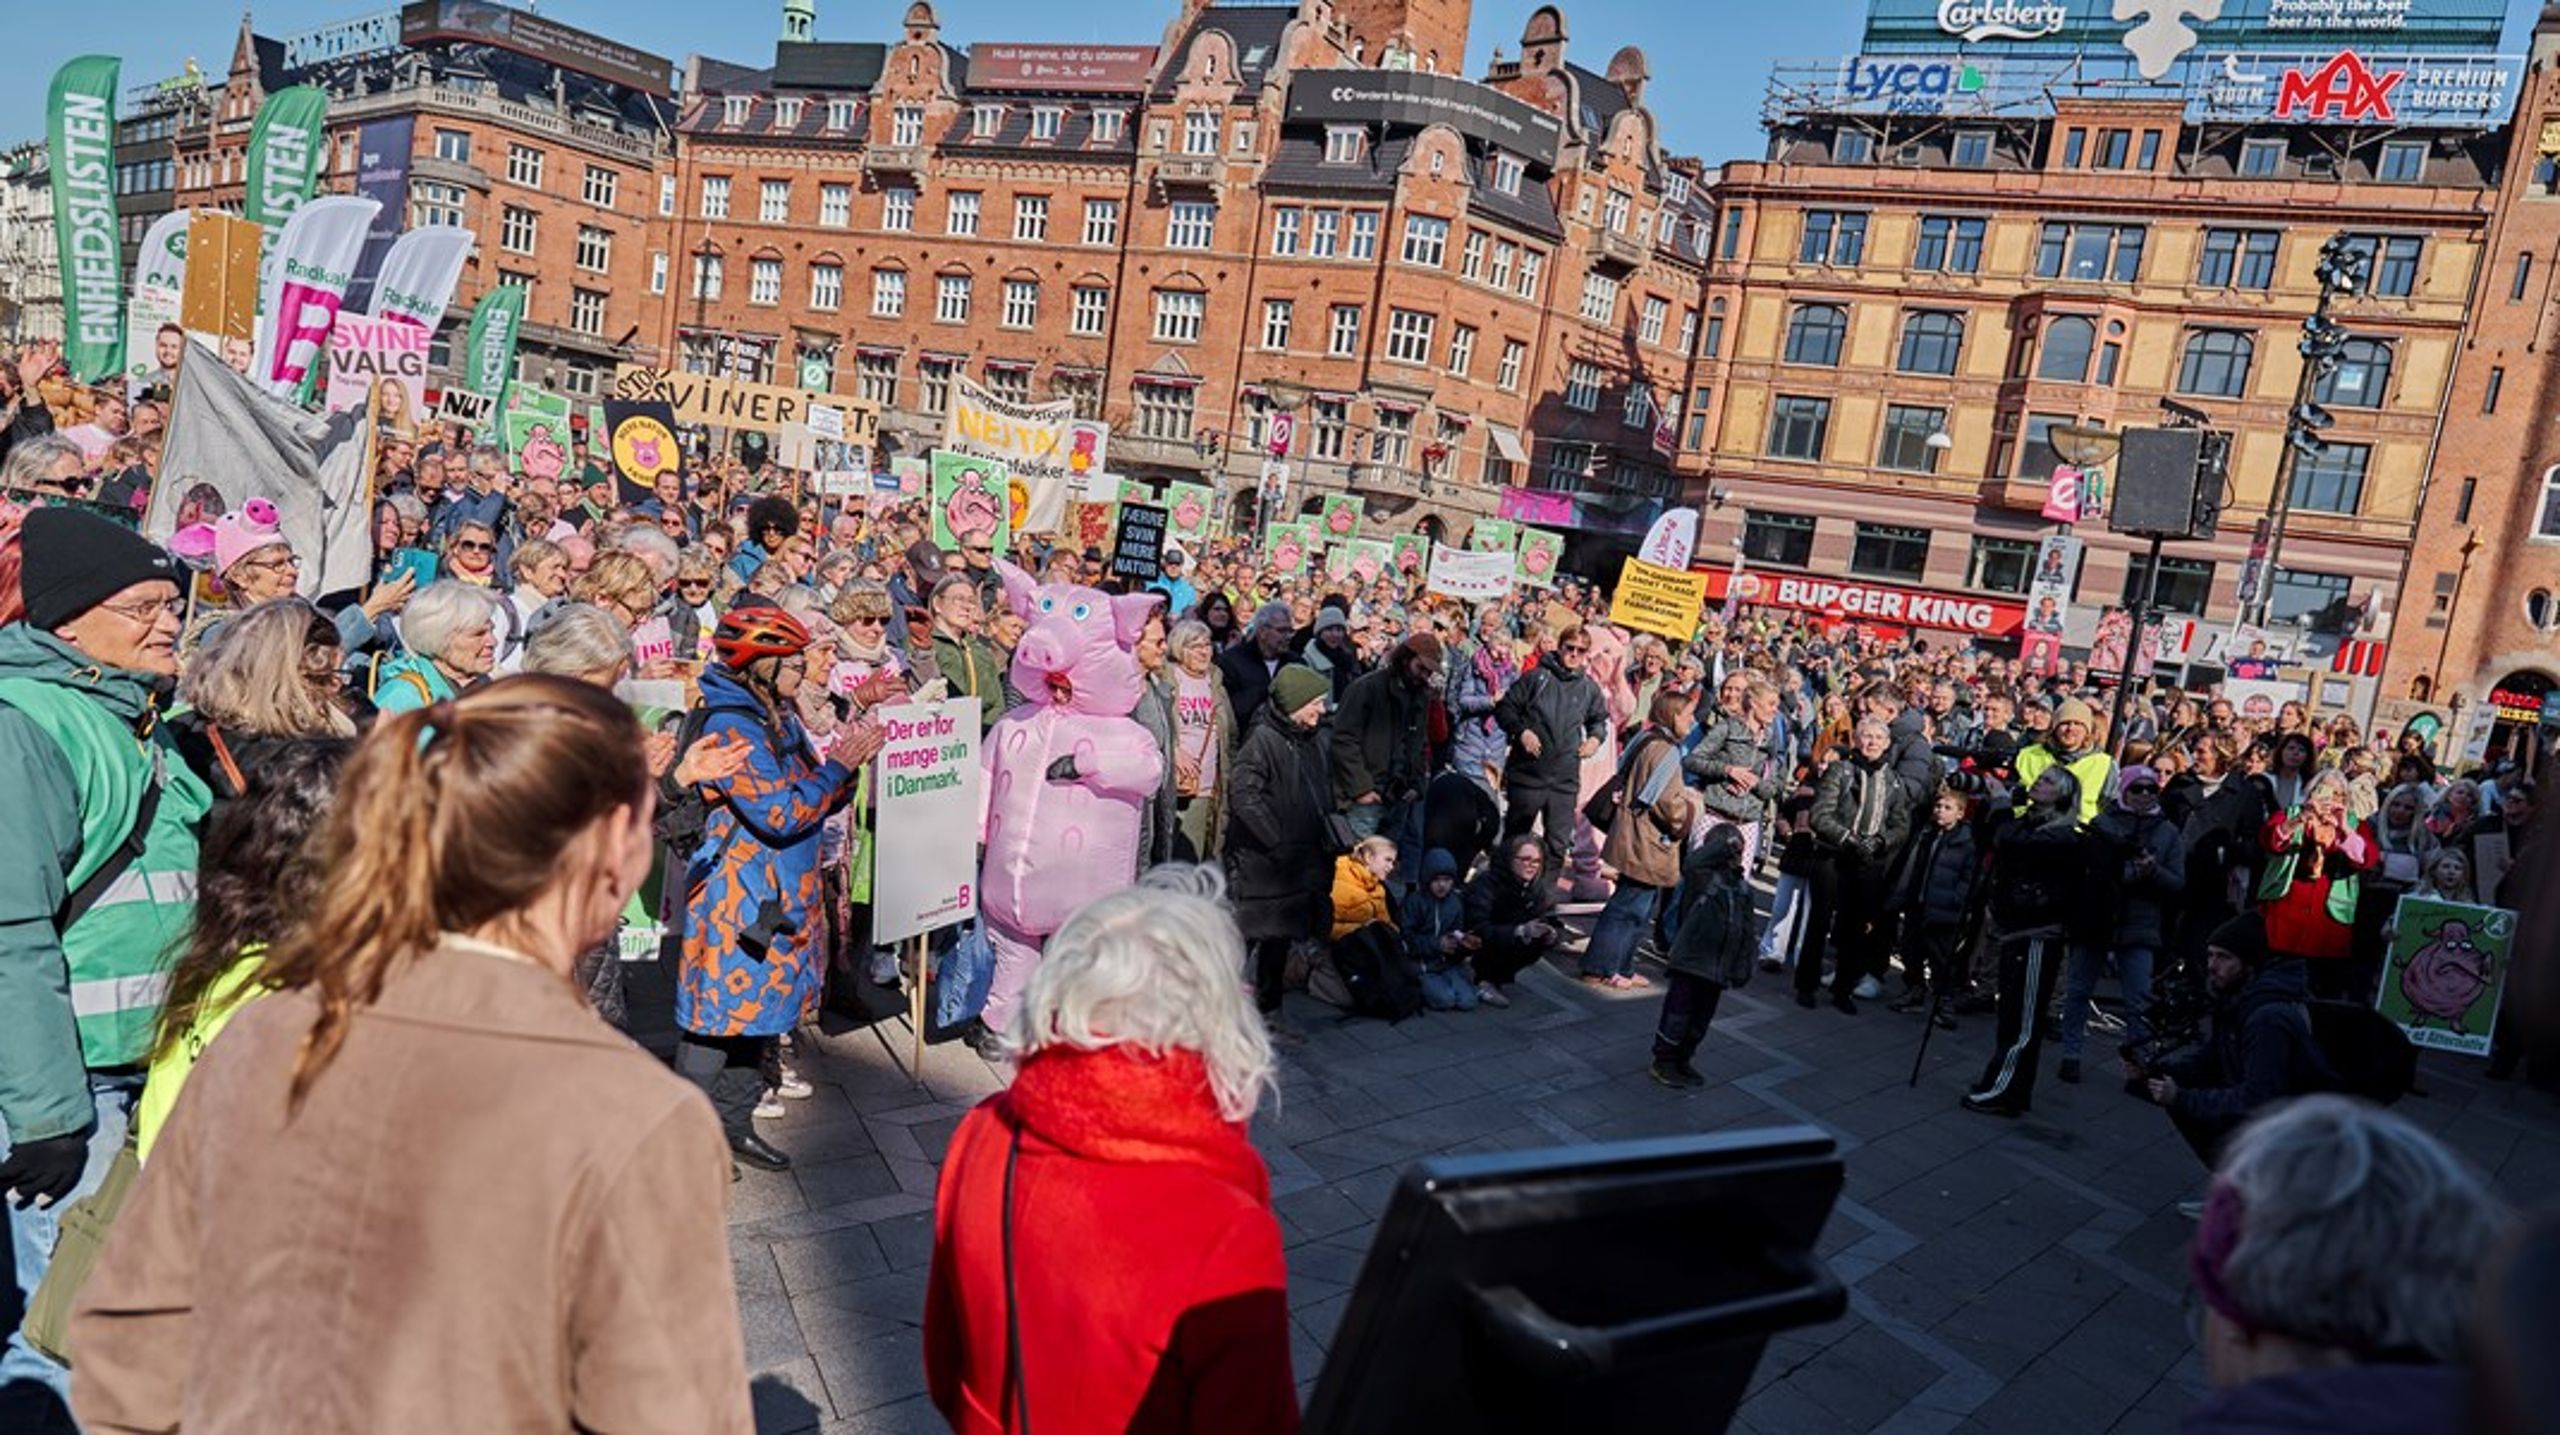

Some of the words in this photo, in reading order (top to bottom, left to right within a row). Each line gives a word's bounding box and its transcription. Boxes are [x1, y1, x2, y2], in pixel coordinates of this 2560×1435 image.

[1936, 0, 2067, 36] Carlsberg
[2271, 0, 2343, 13] Probably
[2347, 0, 2373, 10] the
[2376, 0, 2412, 10] best
[2267, 14, 2303, 27] beer
[2306, 14, 2322, 27] in
[2326, 14, 2353, 27] the
[2356, 14, 2407, 28] world.
[1846, 56, 1951, 100] Lyca
[2274, 49, 2408, 120] MAX
[2416, 69, 2508, 88] PREMIUM
[1888, 95, 1944, 114] Mobile
[2412, 90, 2503, 109] BURGERS
[64, 91, 119, 344] ENHEDSLISTEN
[333, 323, 431, 351] SVINE
[332, 349, 423, 377] VALG
[956, 405, 1011, 449] NEJ
[1121, 507, 1166, 528] FÆRRE
[1125, 526, 1156, 542] SVIN
[1119, 542, 1156, 560] MERE
[1114, 558, 1157, 577] NATUR
[1778, 578, 1904, 618] BURGER
[1908, 596, 1994, 629] KING
[887, 719, 915, 742] Der
[917, 720, 932, 738] er
[933, 714, 955, 737] for
[887, 746, 938, 770] mange
[940, 741, 968, 762] svin
[886, 775, 893, 798] i
[895, 767, 962, 798] Danmark.
[958, 884, 971, 909] B
